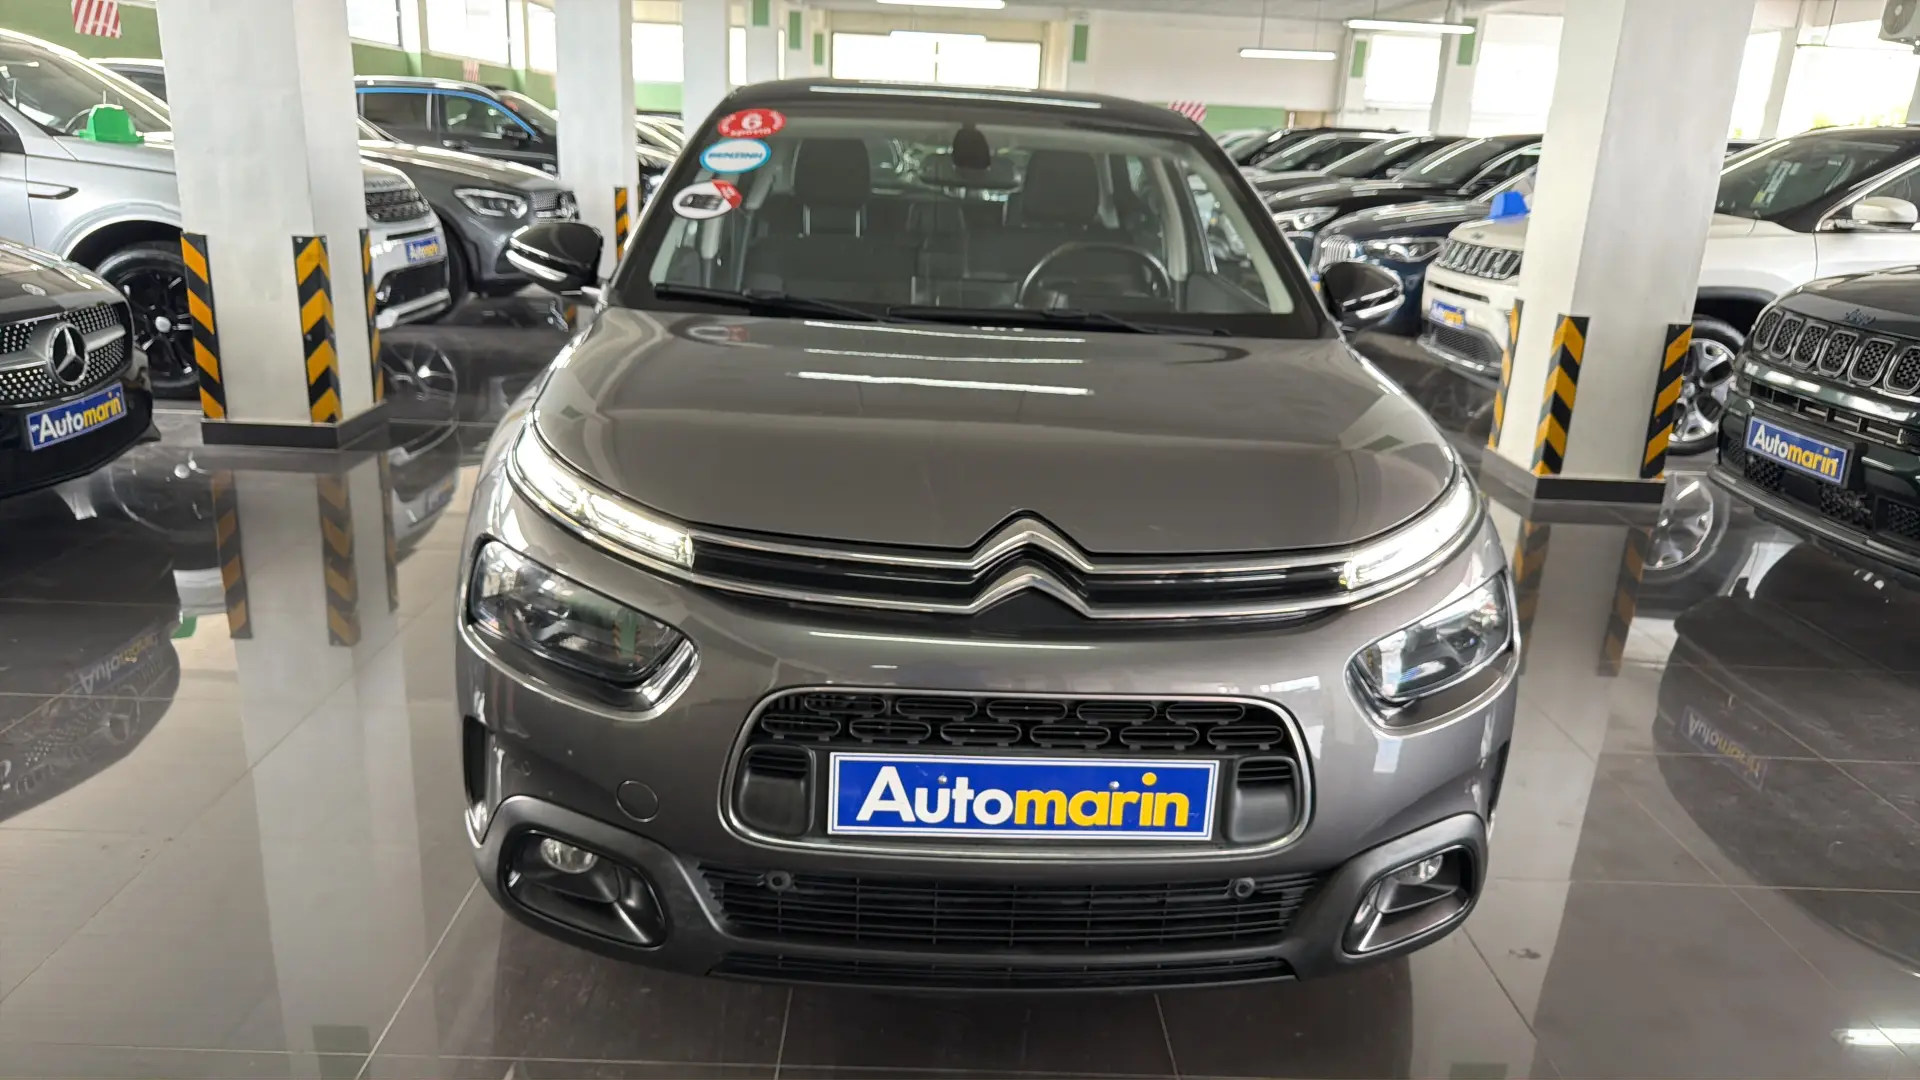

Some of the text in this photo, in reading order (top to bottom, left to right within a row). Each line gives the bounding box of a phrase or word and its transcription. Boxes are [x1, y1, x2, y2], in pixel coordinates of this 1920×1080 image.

[741, 112, 763, 130] 6
[39, 391, 122, 443] Automarin
[1751, 423, 1839, 477] Automarin
[855, 765, 1190, 827] Automarin
